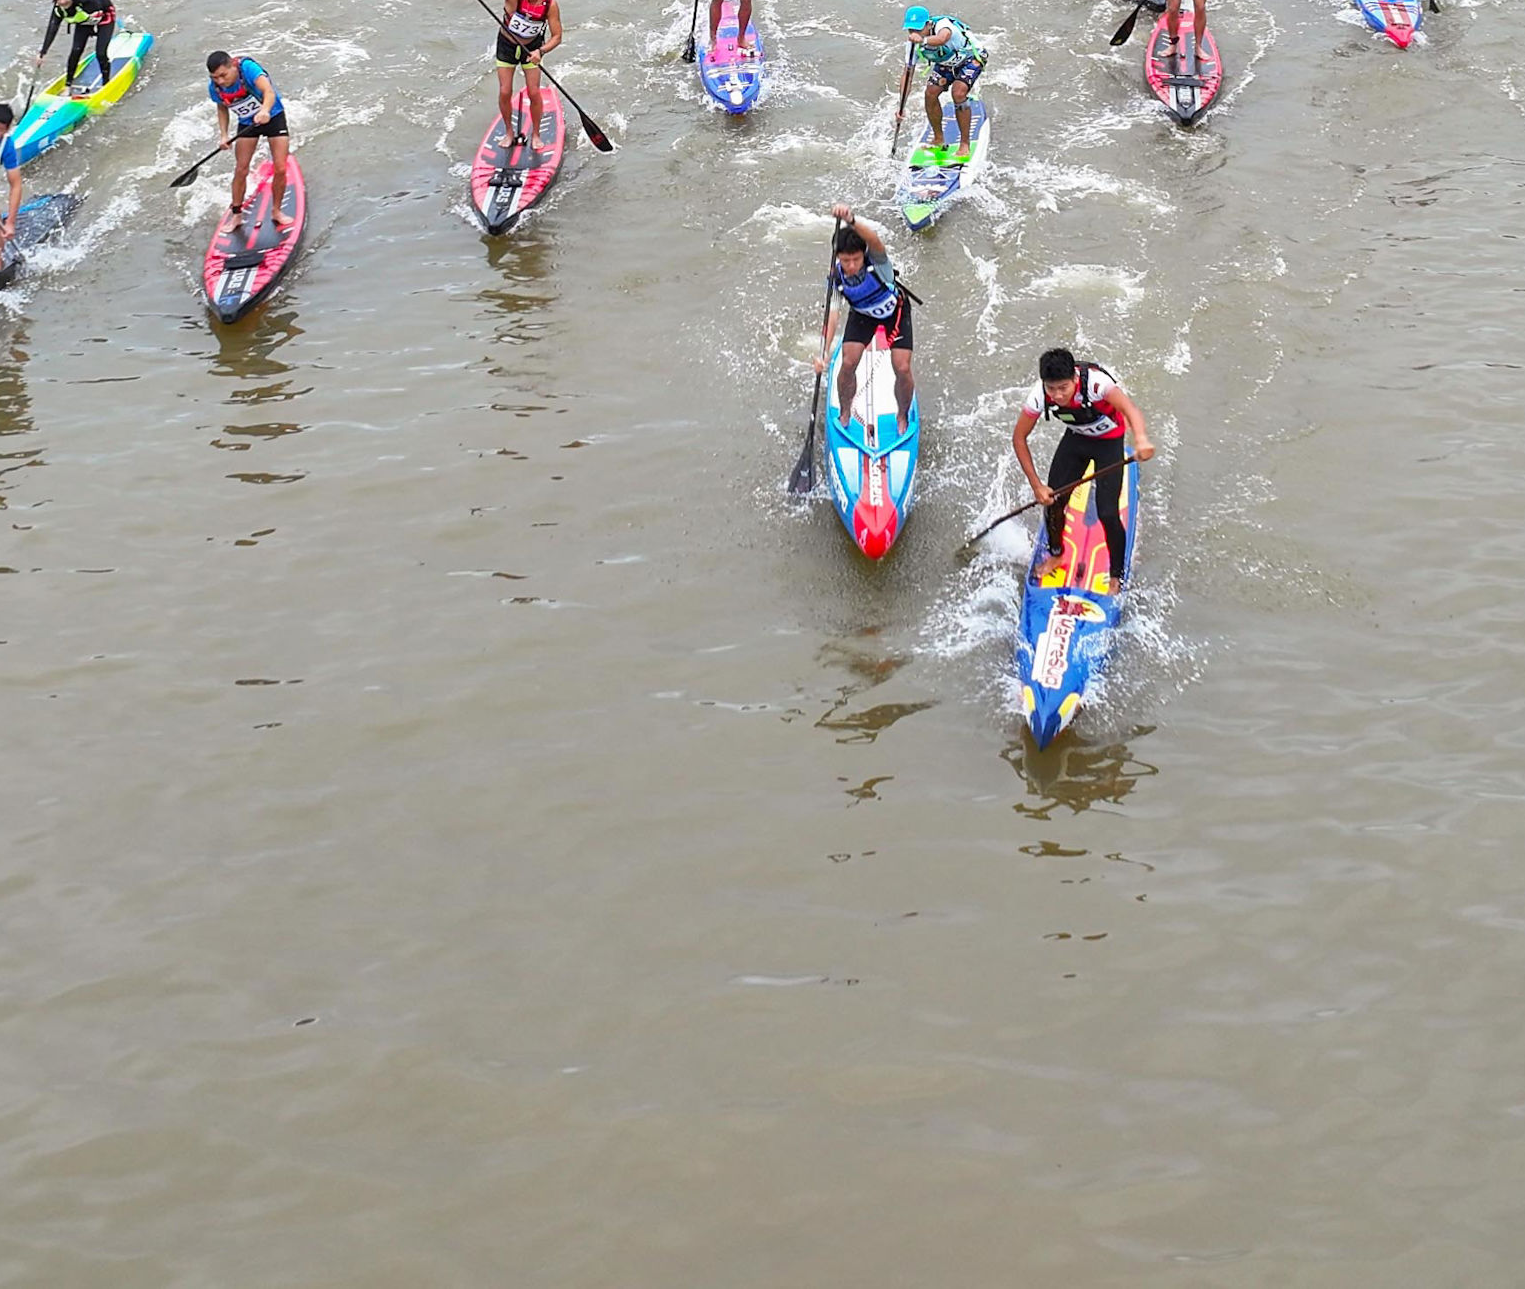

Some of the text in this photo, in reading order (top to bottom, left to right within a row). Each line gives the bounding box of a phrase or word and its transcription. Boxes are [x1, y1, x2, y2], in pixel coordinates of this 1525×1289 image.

[511, 19, 541, 34] 373
[869, 302, 896, 317] 08
[1085, 422, 1109, 434] 16
